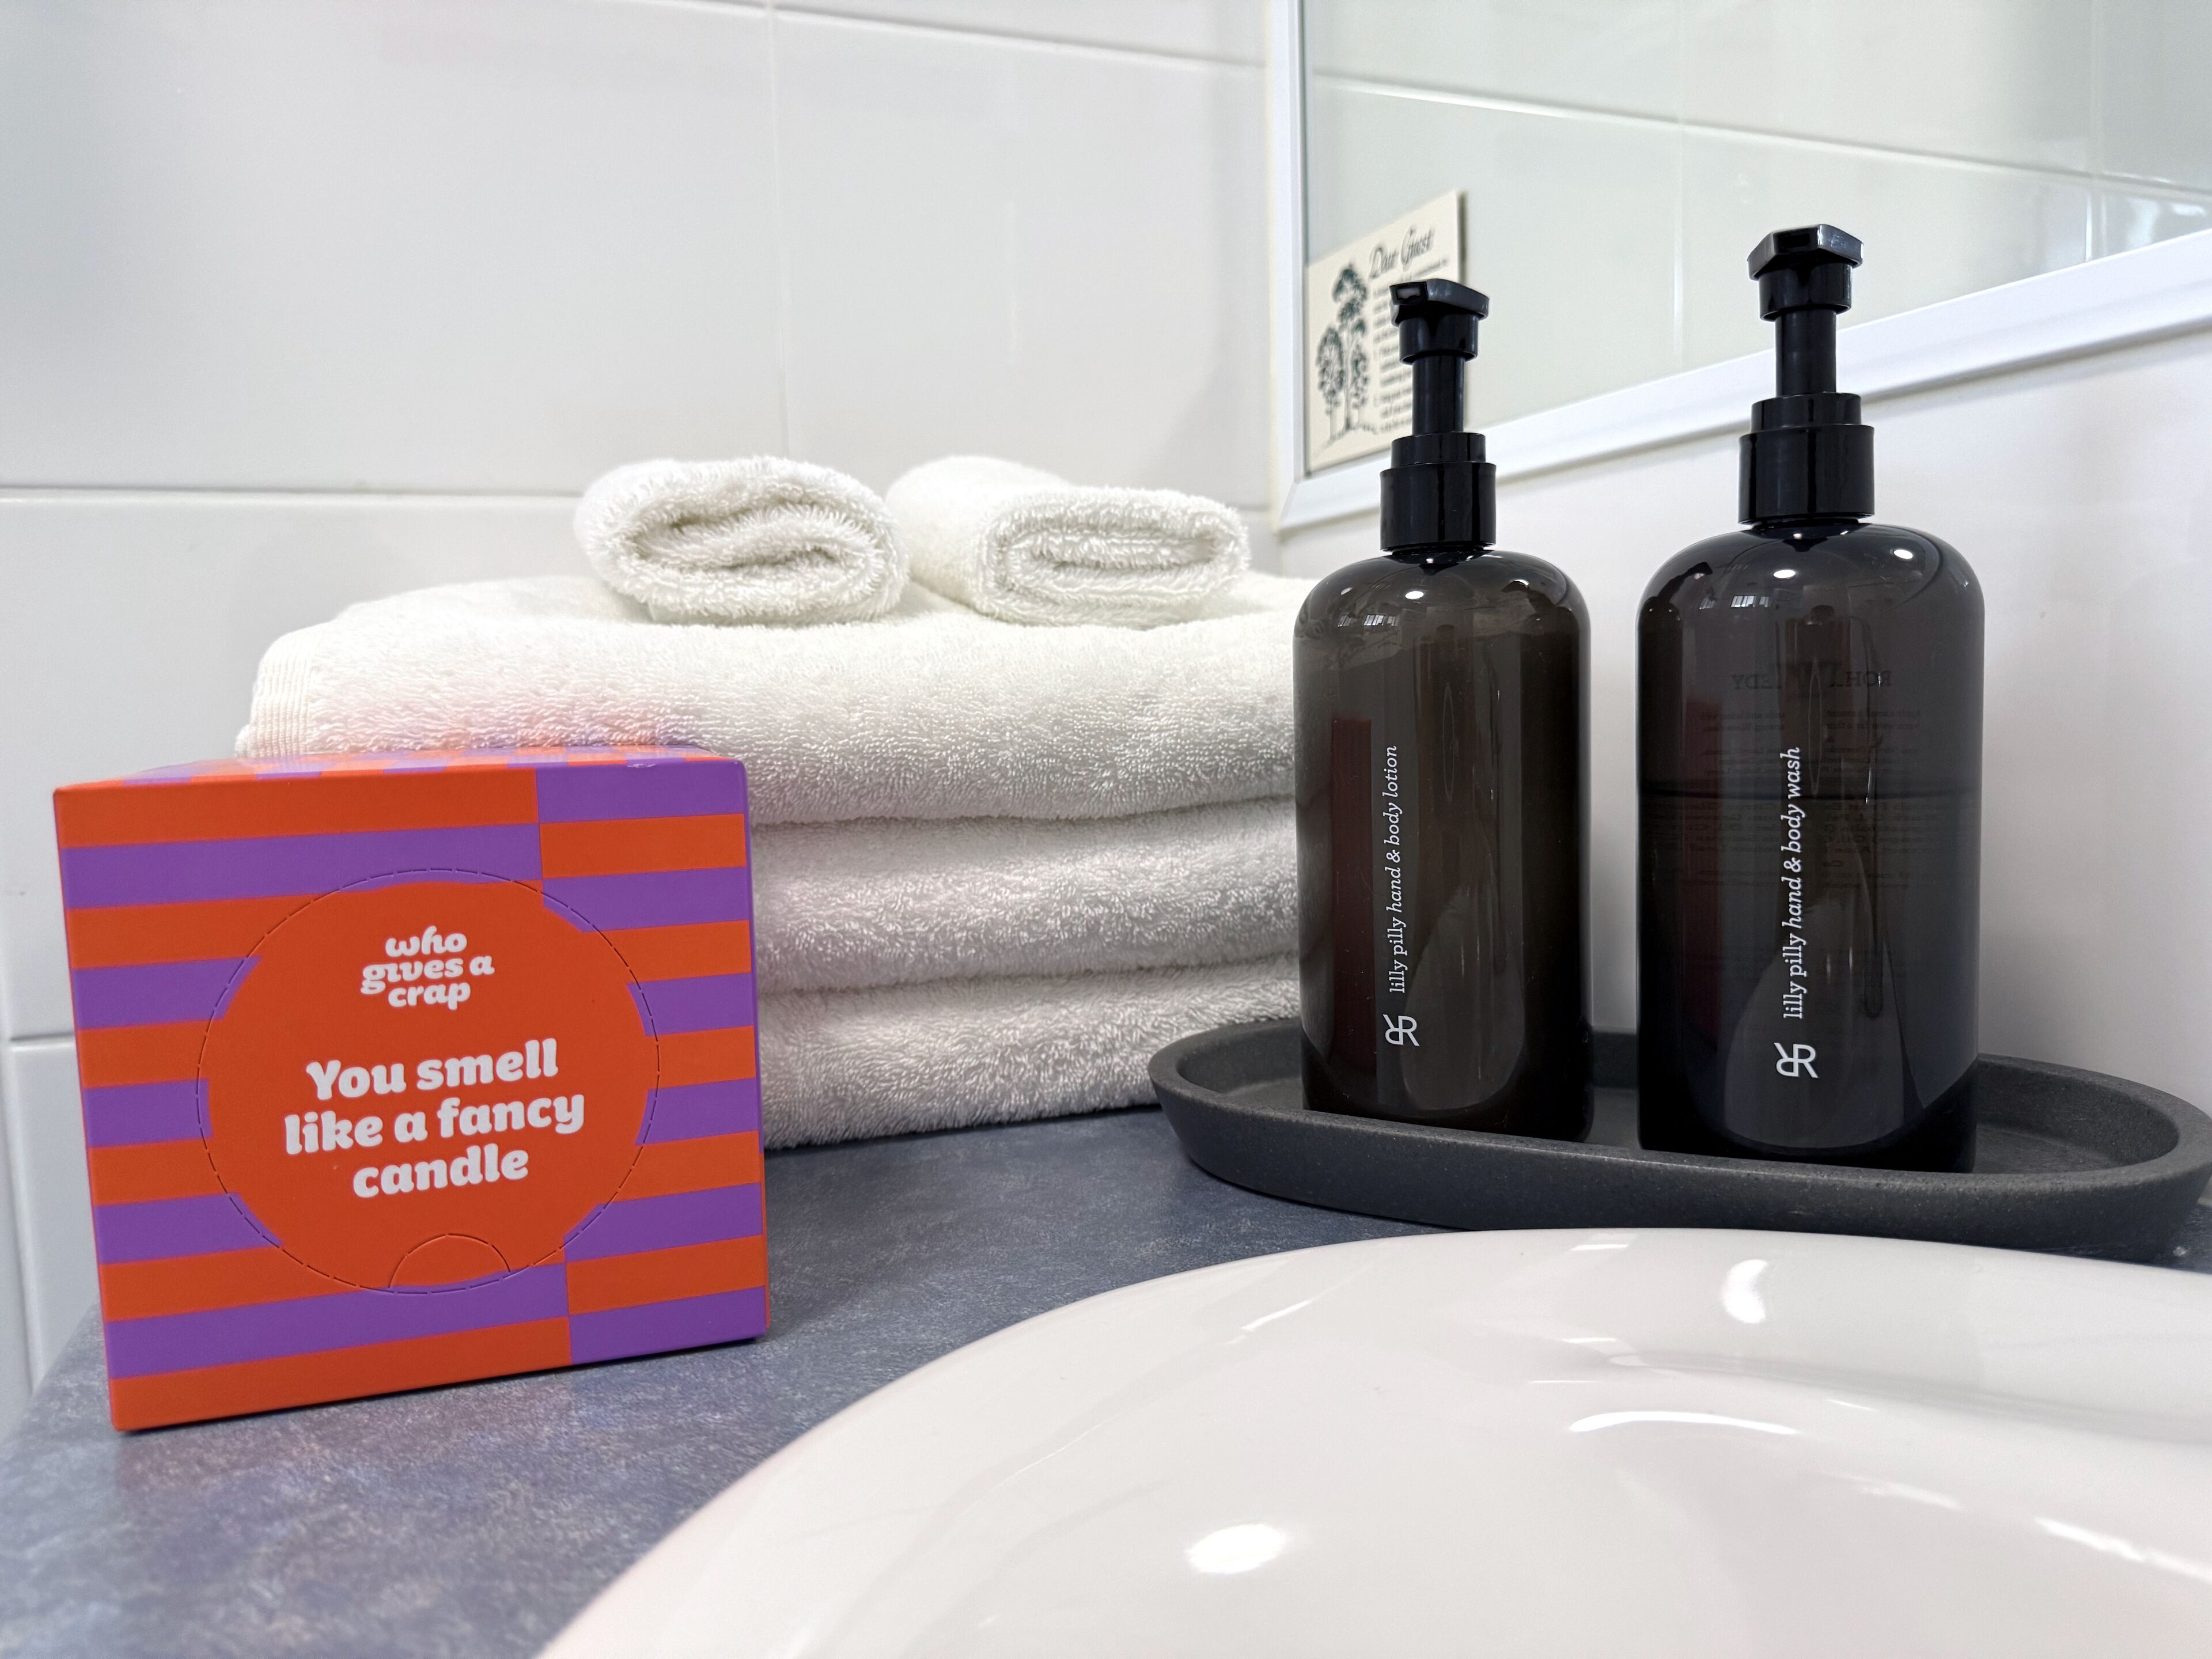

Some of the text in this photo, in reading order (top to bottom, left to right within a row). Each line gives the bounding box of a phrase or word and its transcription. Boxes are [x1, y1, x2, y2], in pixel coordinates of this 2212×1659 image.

[1382, 745, 1408, 993] lilly pilly hand & body lotion
[1779, 747, 1808, 1019] lilly pilly hand & body wash
[385, 925, 467, 957] who
[361, 955, 495, 995] gives a
[388, 981, 471, 1010] crap
[305, 1037, 559, 1101] You smell
[284, 1093, 585, 1155] like a fancy
[353, 1143, 529, 1198] candle
